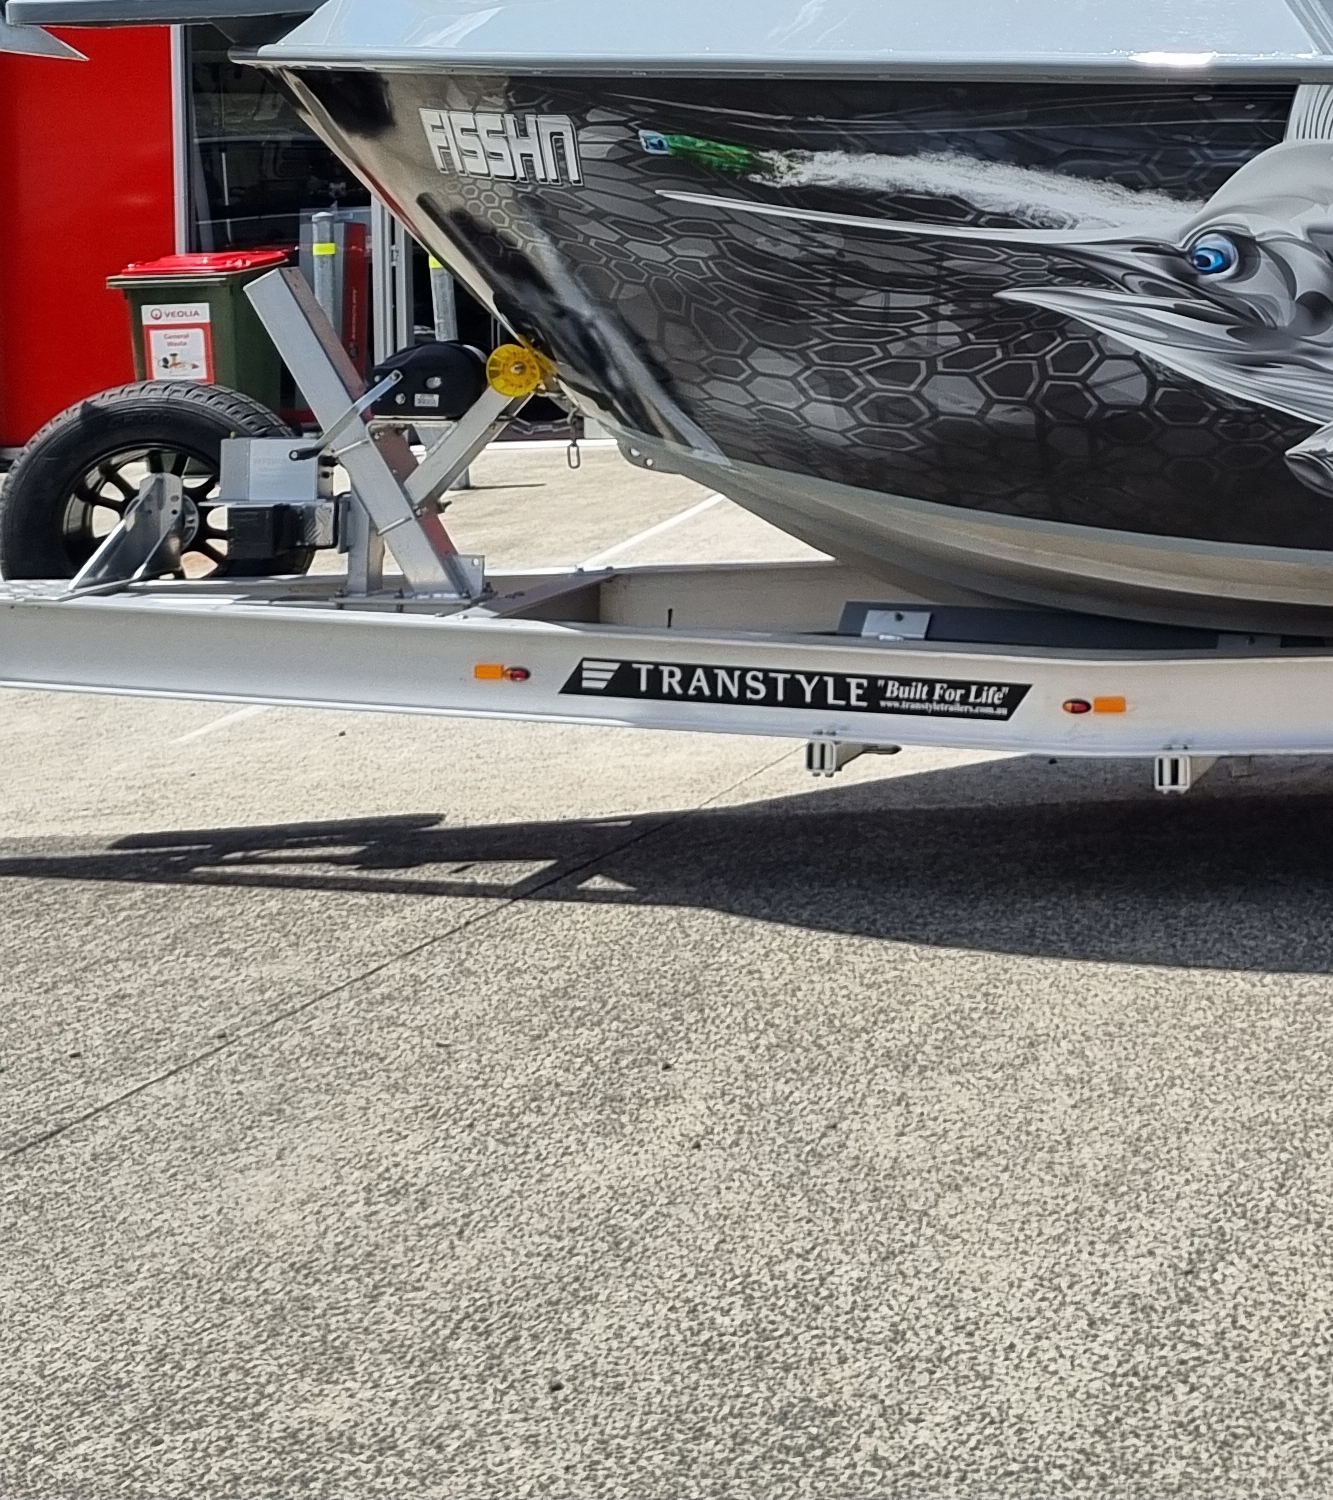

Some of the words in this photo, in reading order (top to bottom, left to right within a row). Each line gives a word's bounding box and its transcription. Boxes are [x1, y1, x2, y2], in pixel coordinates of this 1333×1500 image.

[164, 309, 200, 318] VEOLIA
[631, 662, 869, 707] TRANSTYLE
[932, 682, 965, 703] For
